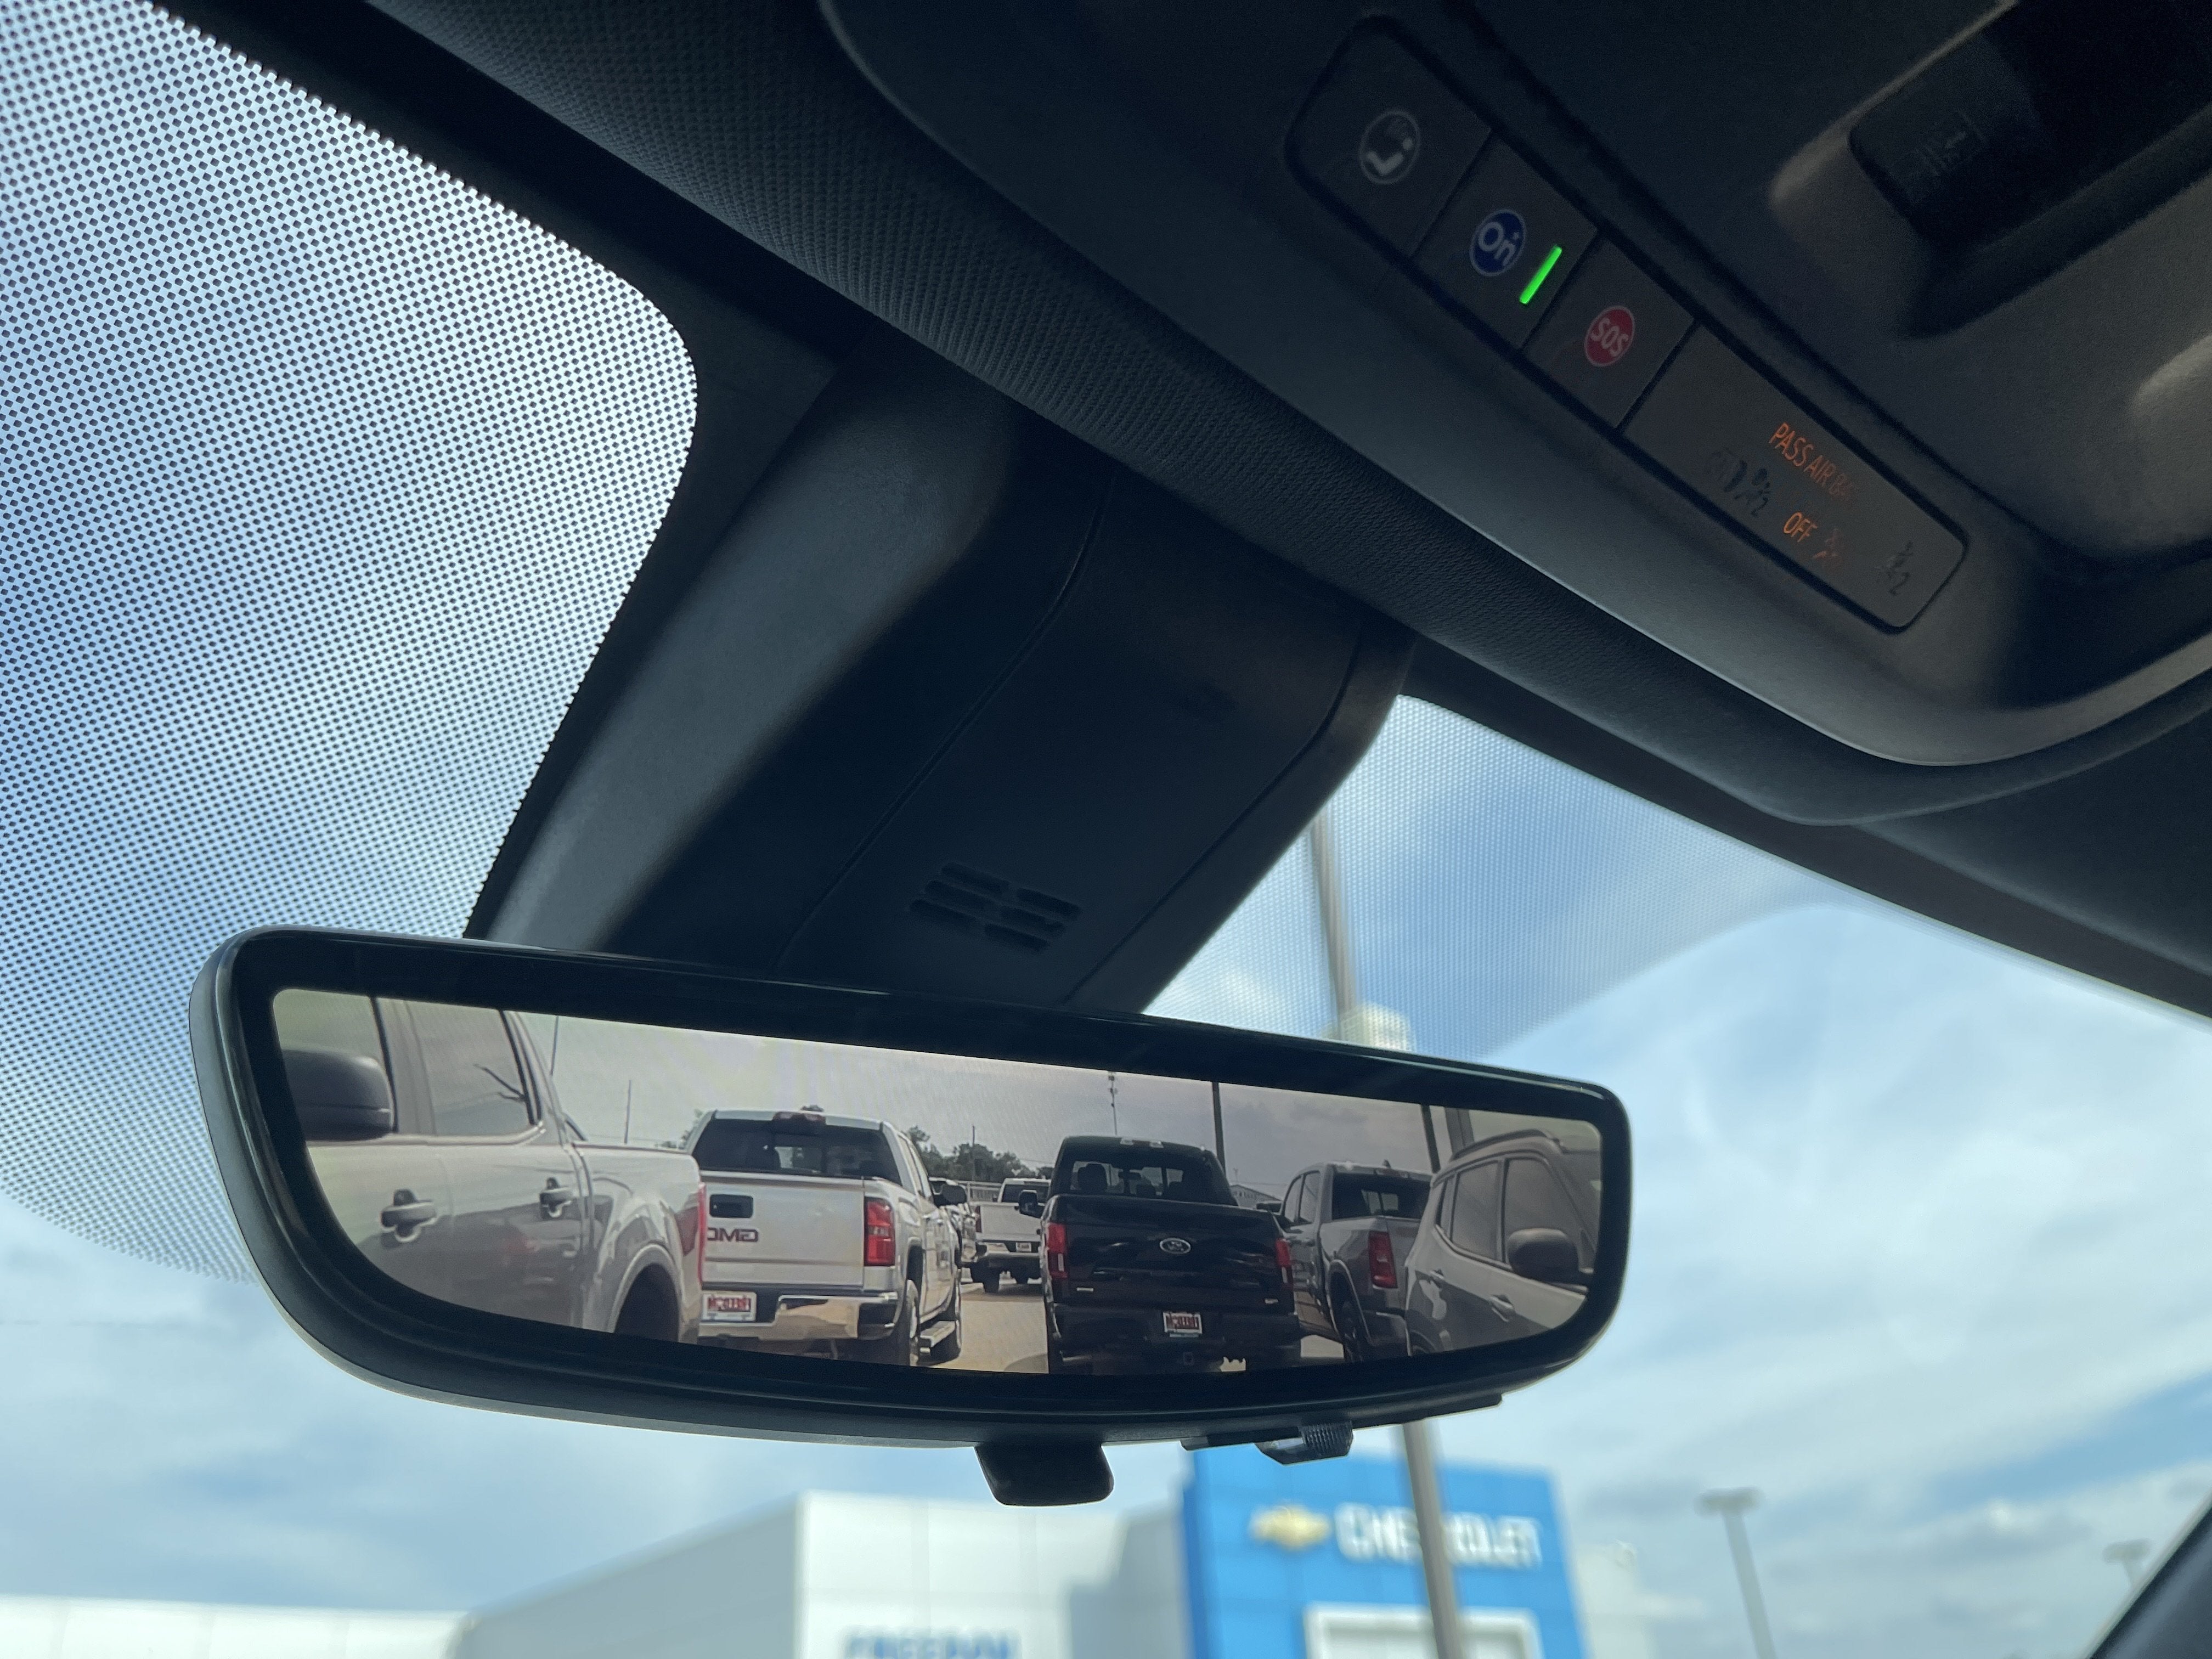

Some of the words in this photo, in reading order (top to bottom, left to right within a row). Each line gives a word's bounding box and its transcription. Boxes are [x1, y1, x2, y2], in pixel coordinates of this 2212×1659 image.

[1477, 221, 1516, 267] On
[1590, 317, 1629, 358] SOS
[1768, 422, 1814, 467] PASS
[1803, 454, 1836, 488] AIR
[1783, 511, 1818, 543] OFF
[1335, 1502, 1543, 1570] CHEOLET
